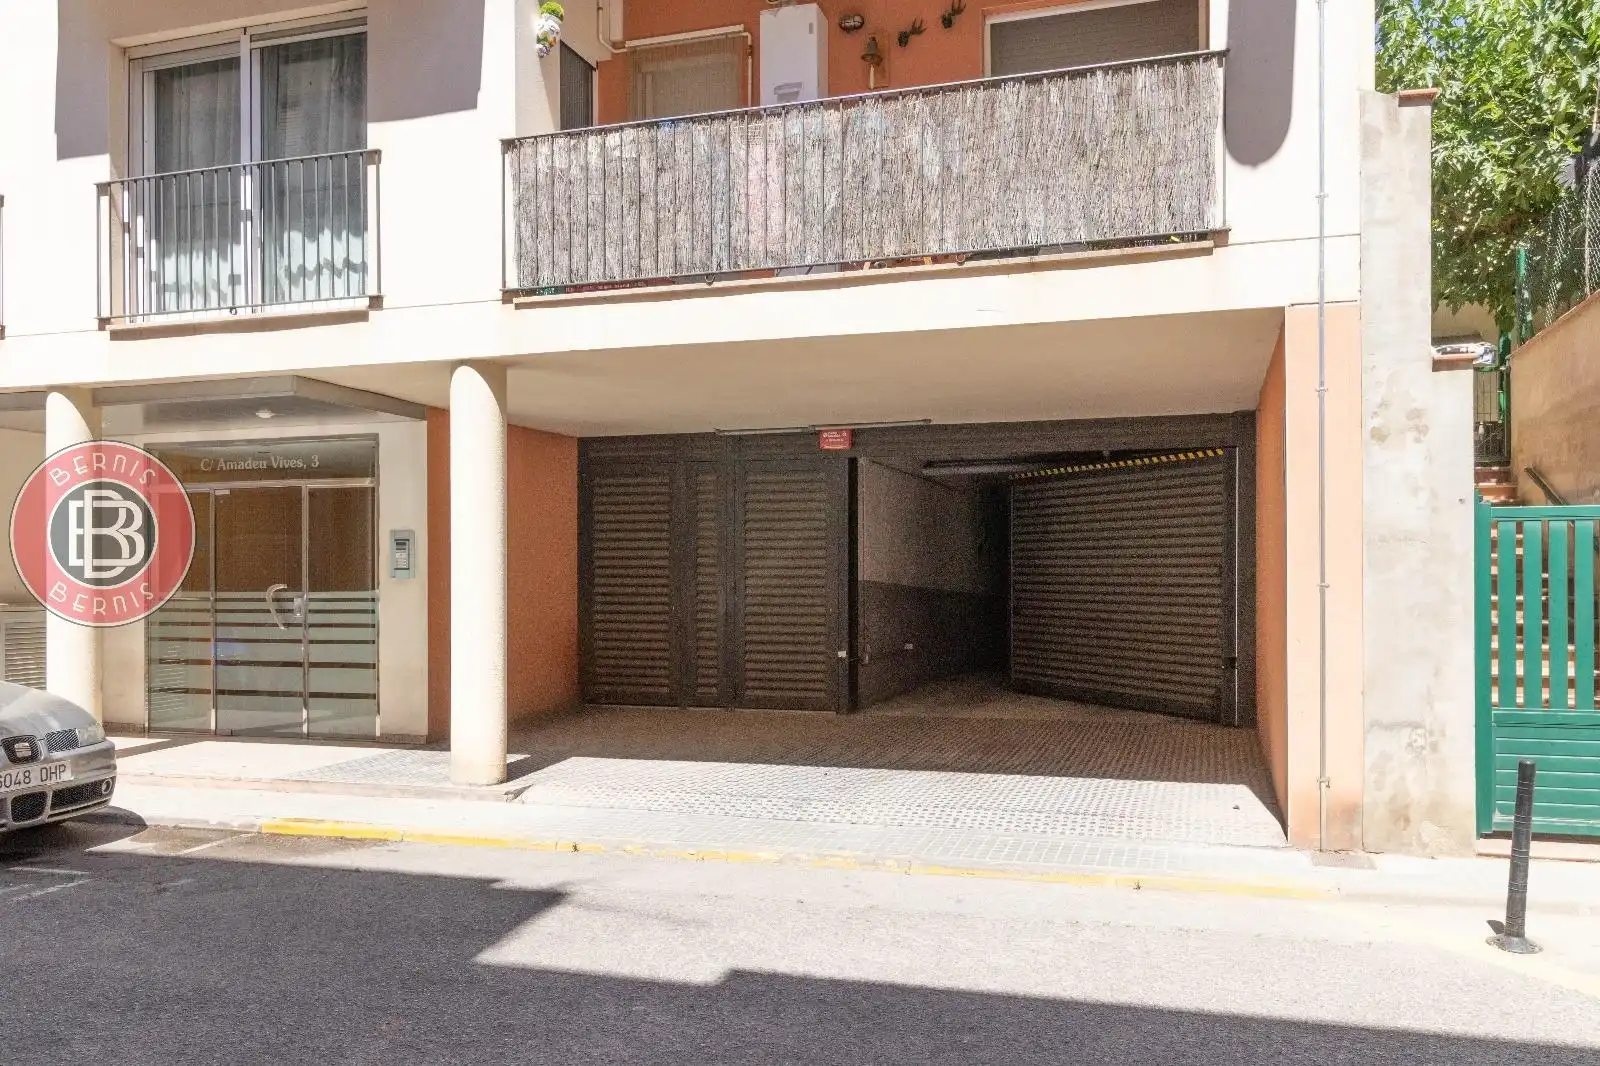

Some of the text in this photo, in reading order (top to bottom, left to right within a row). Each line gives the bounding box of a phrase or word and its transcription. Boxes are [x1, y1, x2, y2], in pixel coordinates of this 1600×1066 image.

[200, 454, 320, 471] C/ Amadeu Vives, 3
[0, 764, 67, 789] 048 DHP
